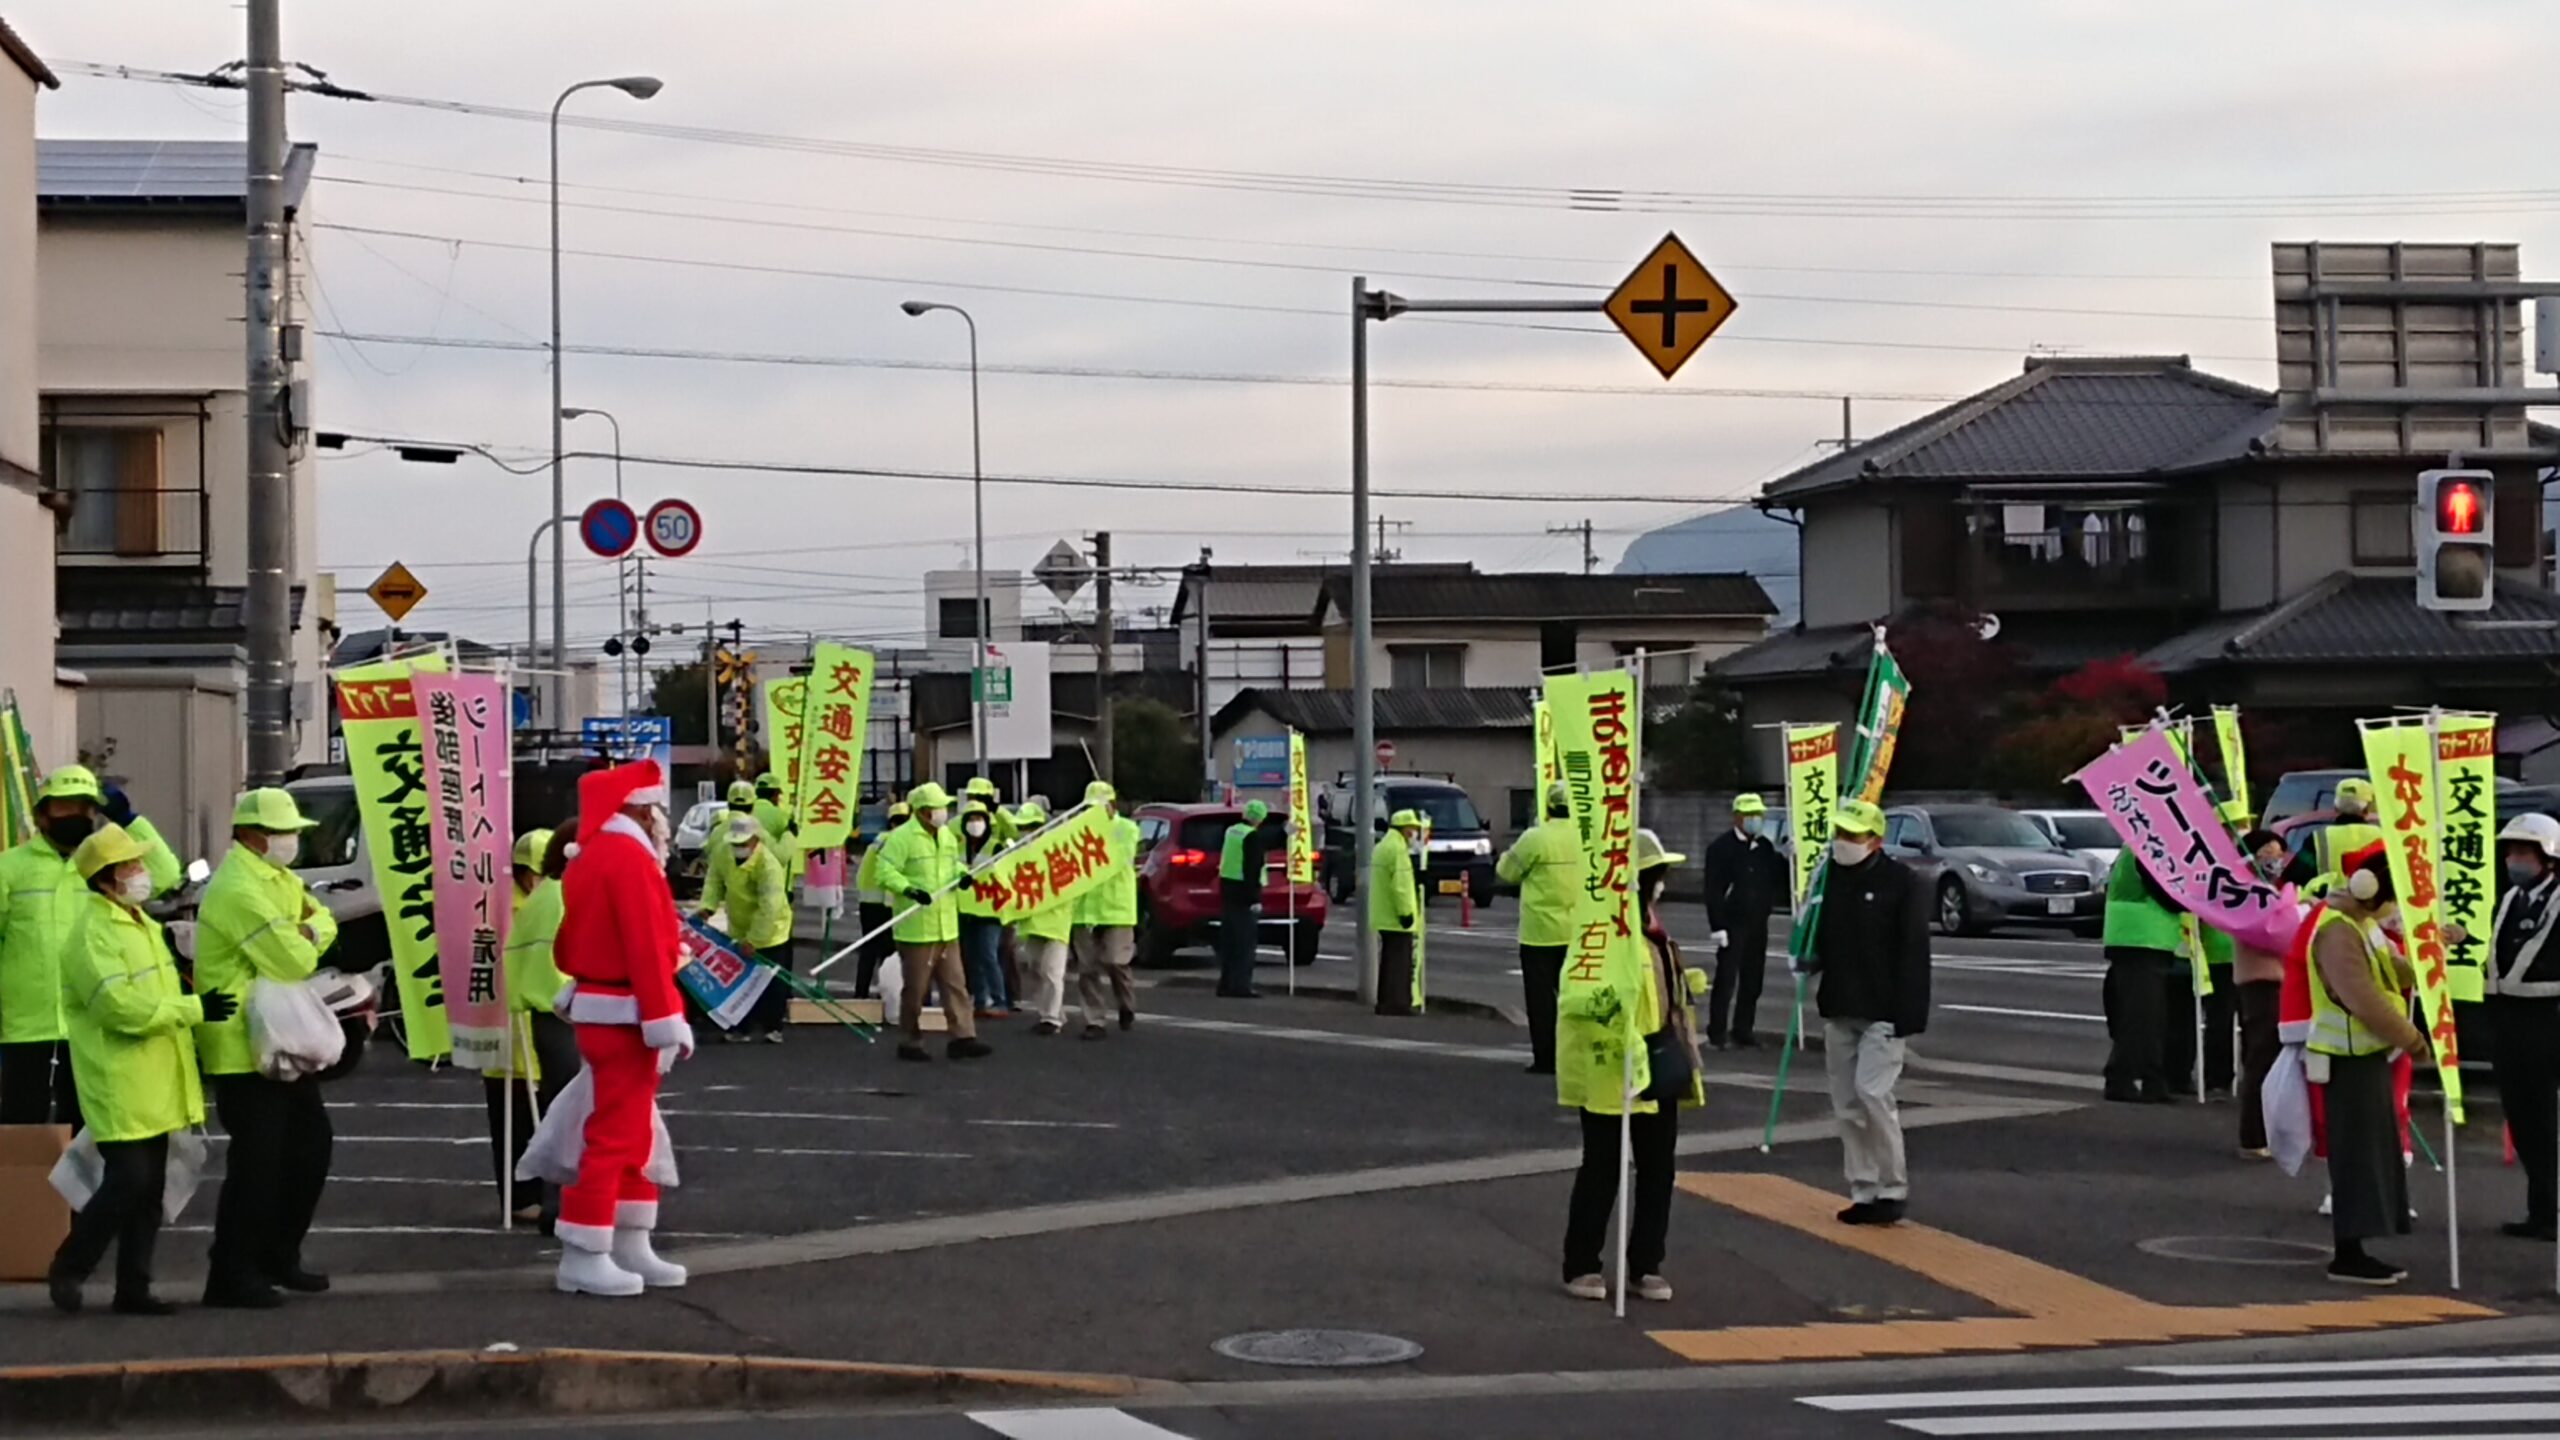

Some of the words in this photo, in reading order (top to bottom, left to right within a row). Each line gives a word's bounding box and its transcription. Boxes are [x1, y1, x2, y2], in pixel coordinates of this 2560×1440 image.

[657, 515, 689, 540] 50
[808, 661, 860, 824] 交通安全
[2440, 728, 2492, 757] マナーアップ
[973, 826, 1111, 912] 交通安全
[2441, 766, 2487, 967] 交通安全
[1568, 920, 1609, 981] 右左
